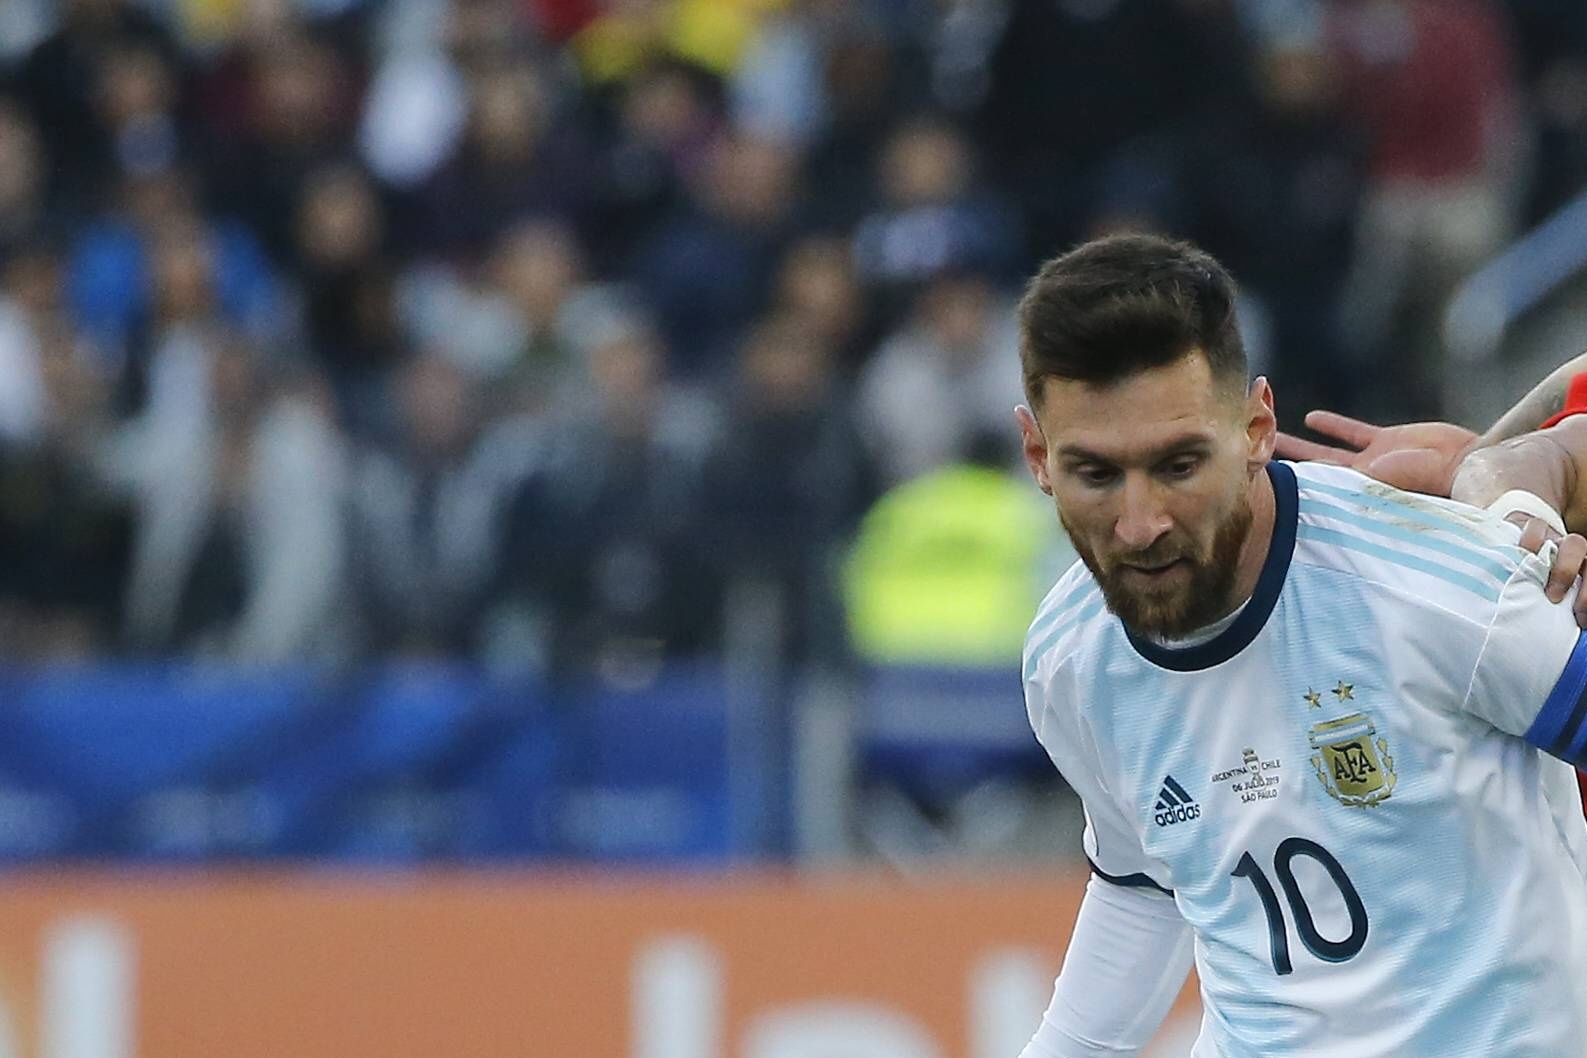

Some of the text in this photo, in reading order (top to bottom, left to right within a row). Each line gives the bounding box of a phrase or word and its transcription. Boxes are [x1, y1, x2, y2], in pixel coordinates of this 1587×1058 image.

[1261, 759, 1282, 771] CHILE
[1330, 741, 1377, 784] AFA
[1155, 804, 1201, 827] adidas
[1230, 836, 1370, 976] 10
